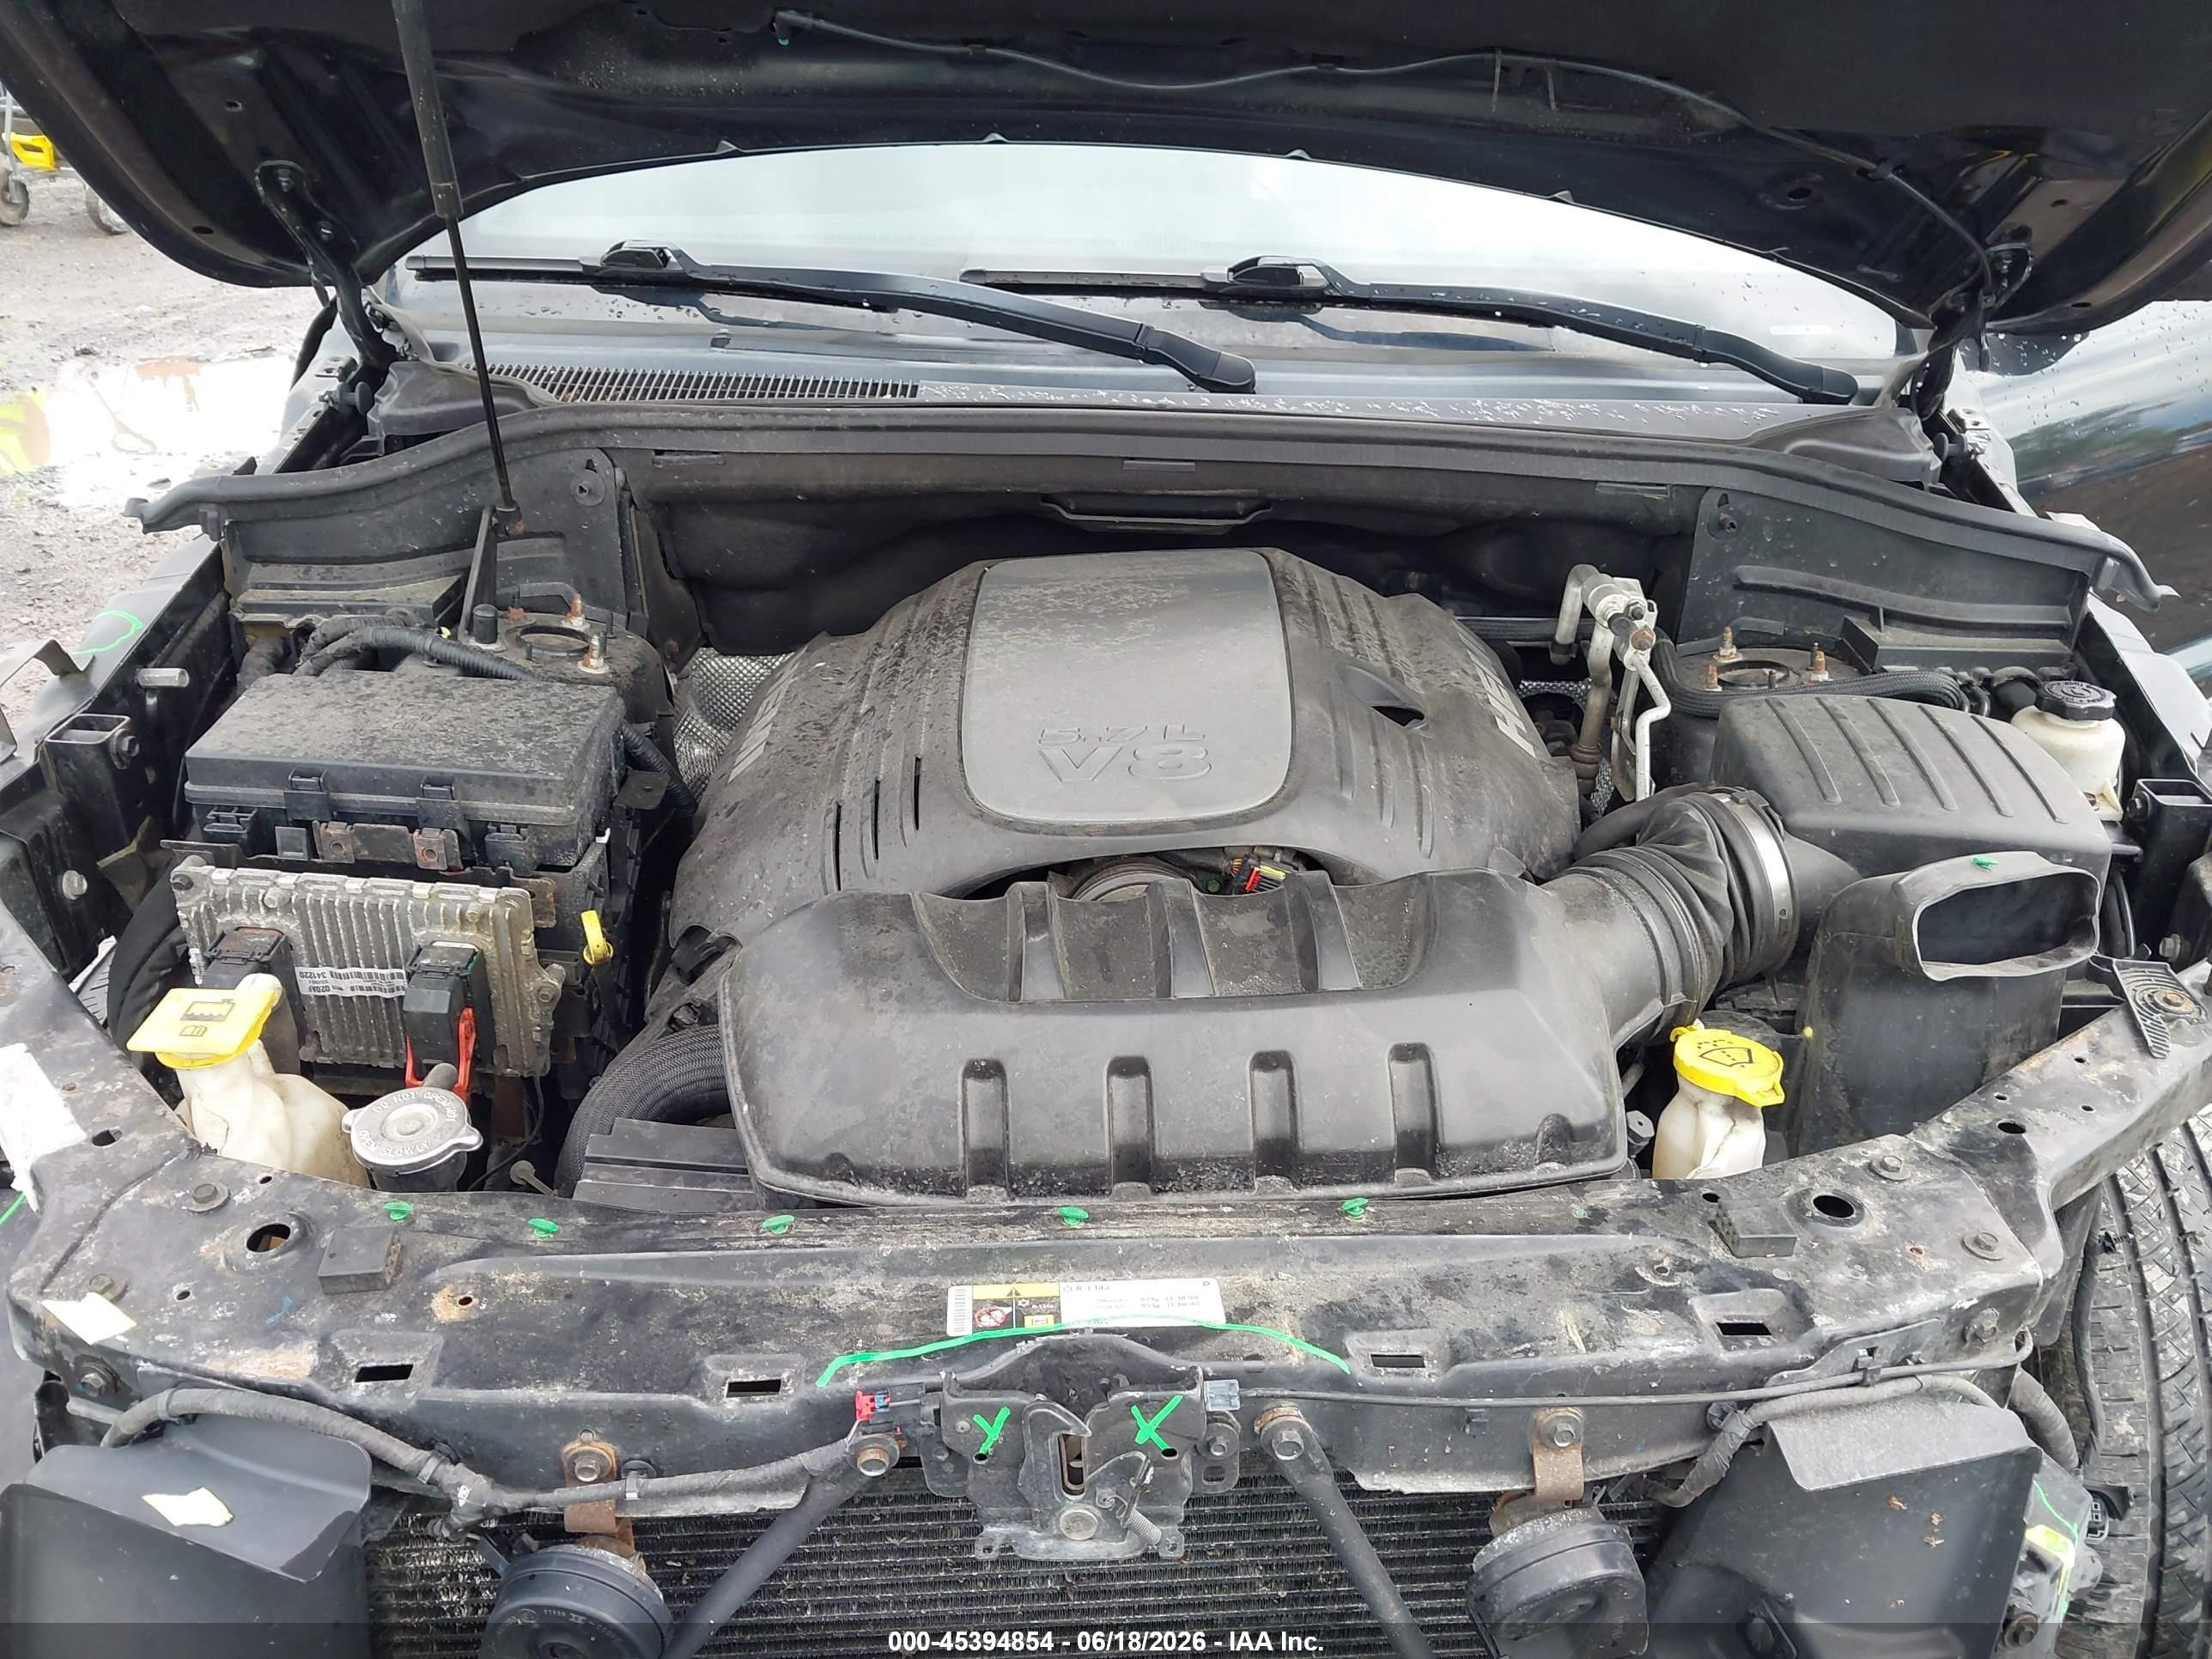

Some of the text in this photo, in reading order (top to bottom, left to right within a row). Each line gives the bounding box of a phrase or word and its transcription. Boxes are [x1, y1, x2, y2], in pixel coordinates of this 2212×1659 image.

[1037, 723, 1206, 745] 5.7L
[1037, 744, 1212, 783] V8
[374, 1102, 389, 1114] DO
[393, 1091, 419, 1103] NOT
